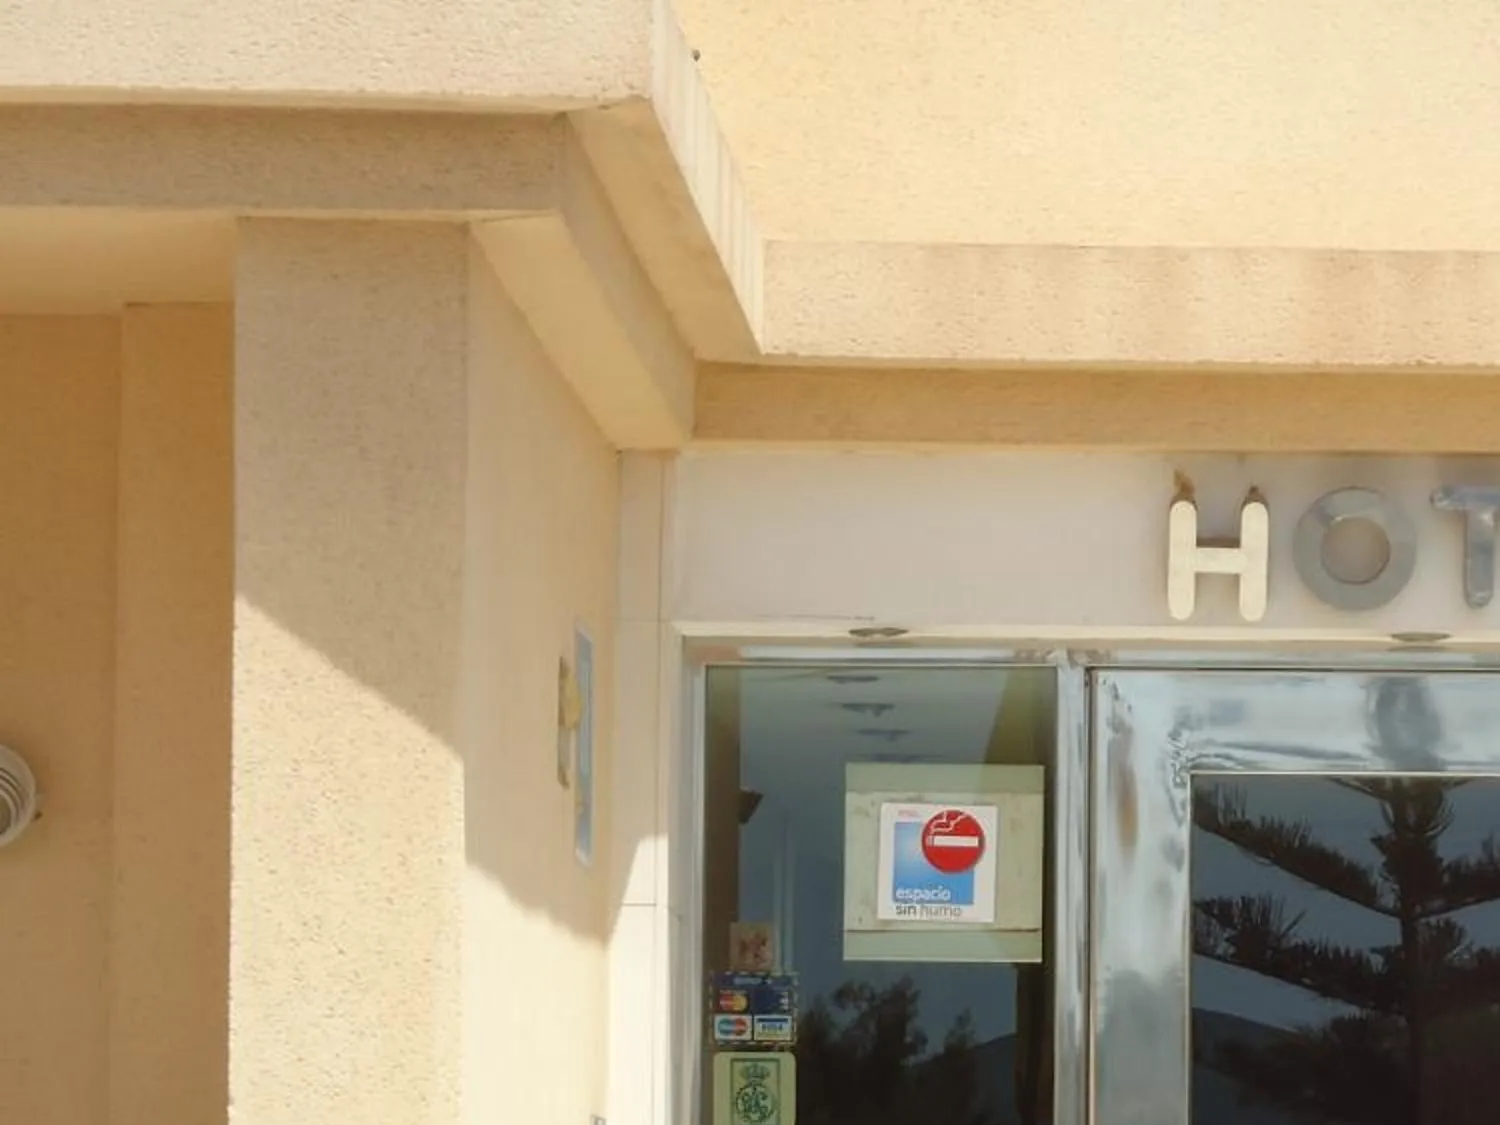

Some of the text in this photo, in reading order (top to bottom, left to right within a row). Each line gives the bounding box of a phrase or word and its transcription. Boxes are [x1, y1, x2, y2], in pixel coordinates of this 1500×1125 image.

[896, 885, 951, 904] espacio
[896, 904, 962, 917] sin humo
